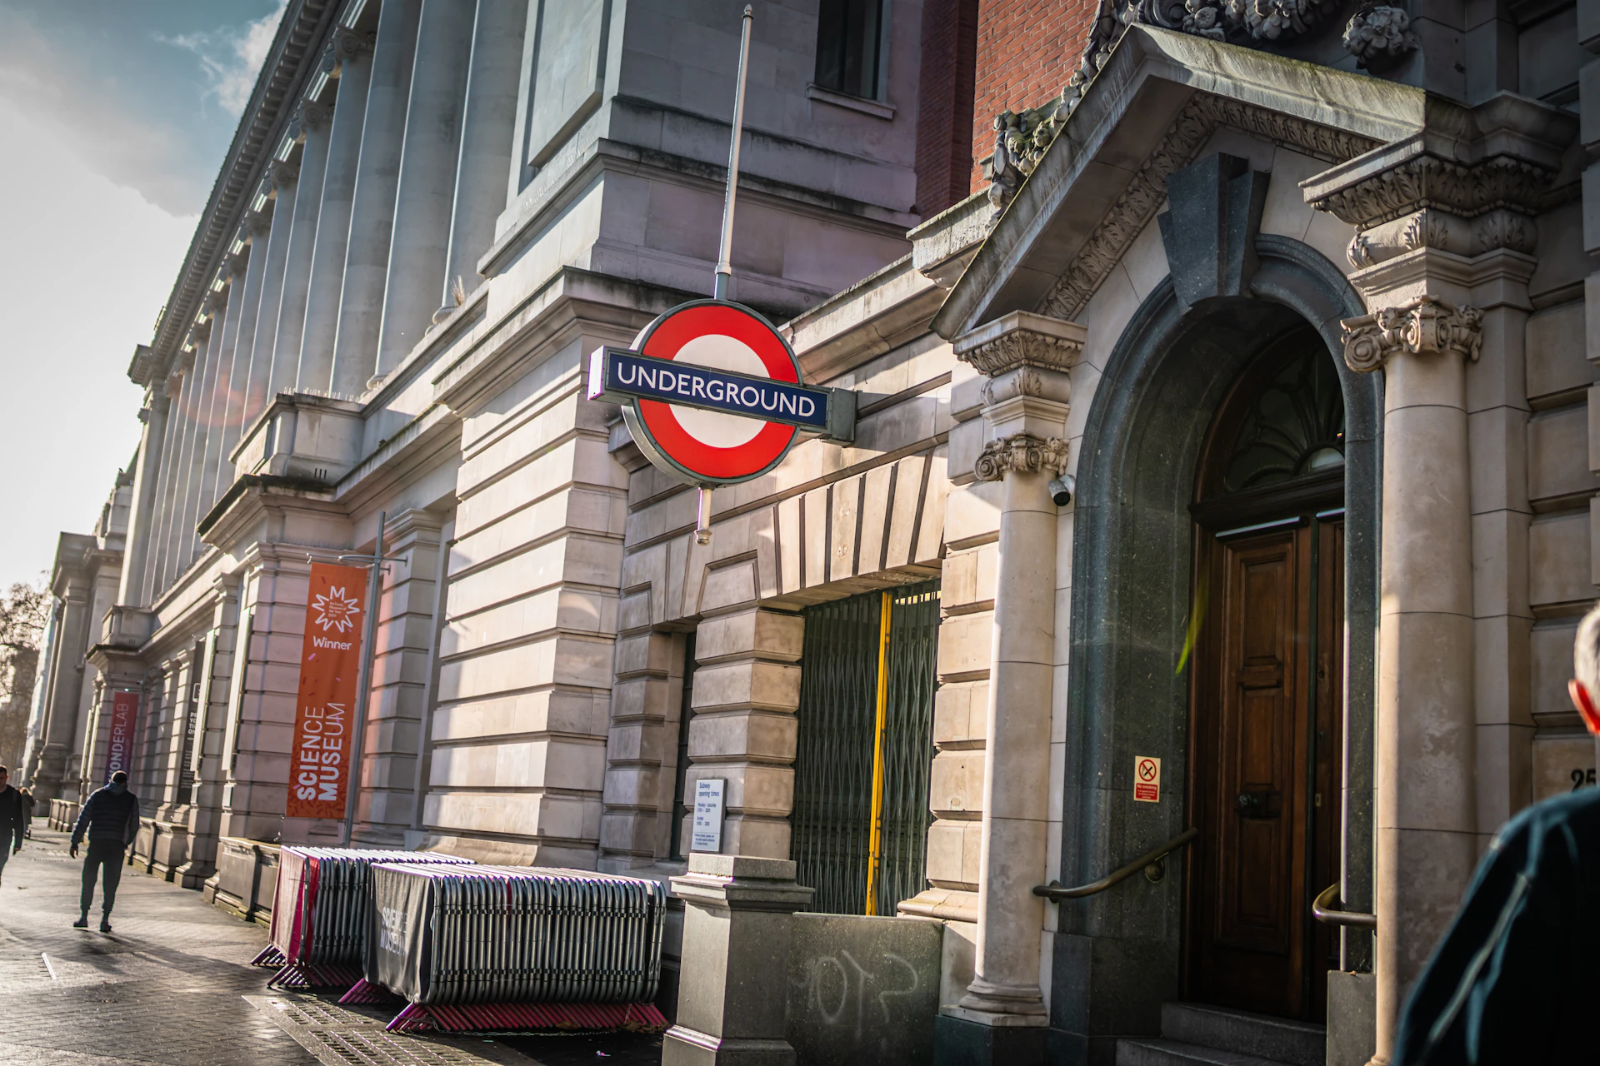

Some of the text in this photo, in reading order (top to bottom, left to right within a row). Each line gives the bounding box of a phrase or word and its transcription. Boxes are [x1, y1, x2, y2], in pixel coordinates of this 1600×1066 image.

[616, 361, 817, 418] UNDERGROUND
[312, 635, 352, 651] Winner
[296, 706, 325, 801] SCIENCE
[317, 702, 346, 801] MUSEUM
